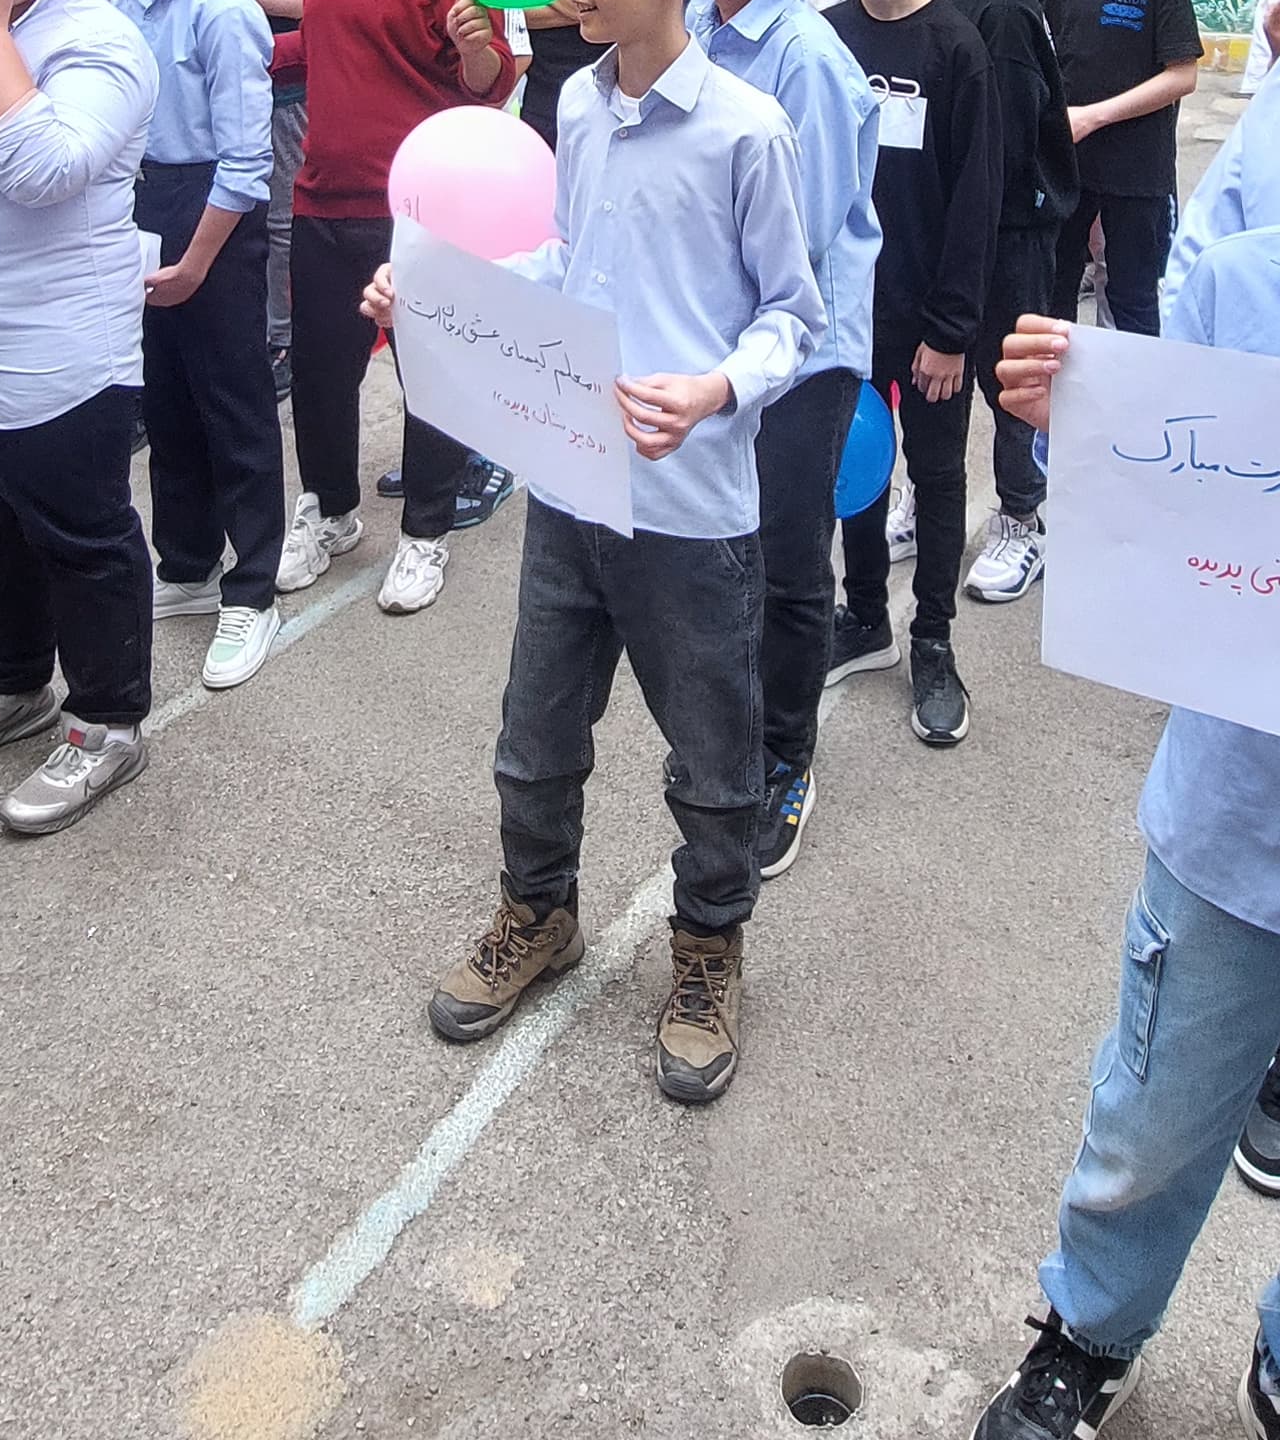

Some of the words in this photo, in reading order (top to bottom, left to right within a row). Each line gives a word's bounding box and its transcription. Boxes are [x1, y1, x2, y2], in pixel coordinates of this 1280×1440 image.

[461, 312, 500, 344] عشق
[1111, 414, 1220, 483] مبارک
[1187, 556, 1242, 596] پدیده
